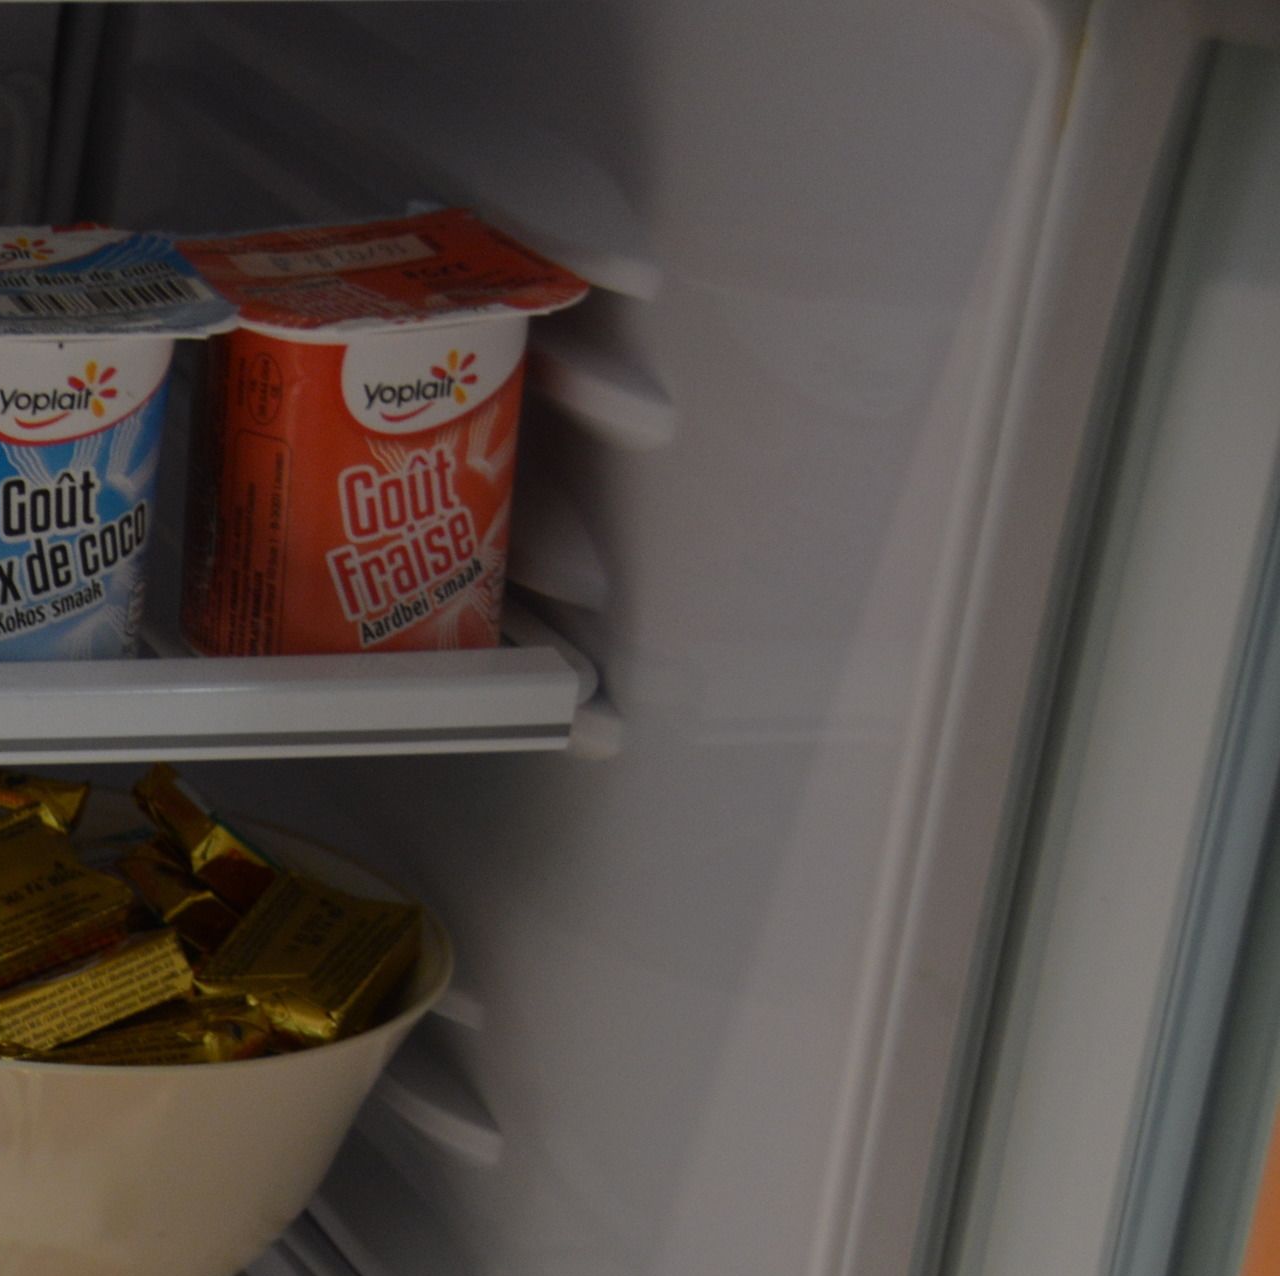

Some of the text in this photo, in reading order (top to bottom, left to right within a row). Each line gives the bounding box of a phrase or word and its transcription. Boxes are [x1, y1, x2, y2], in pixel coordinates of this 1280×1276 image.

[0, 386, 94, 416] Yoplait
[364, 374, 456, 410] Yoplait
[3, 471, 95, 537] Goût
[344, 446, 454, 537] Goût
[26, 539, 72, 596] de
[79, 502, 146, 577] coco
[331, 511, 476, 617] Fraise
[53, 580, 103, 617] smaak
[361, 557, 484, 645] Aardbei smaak
